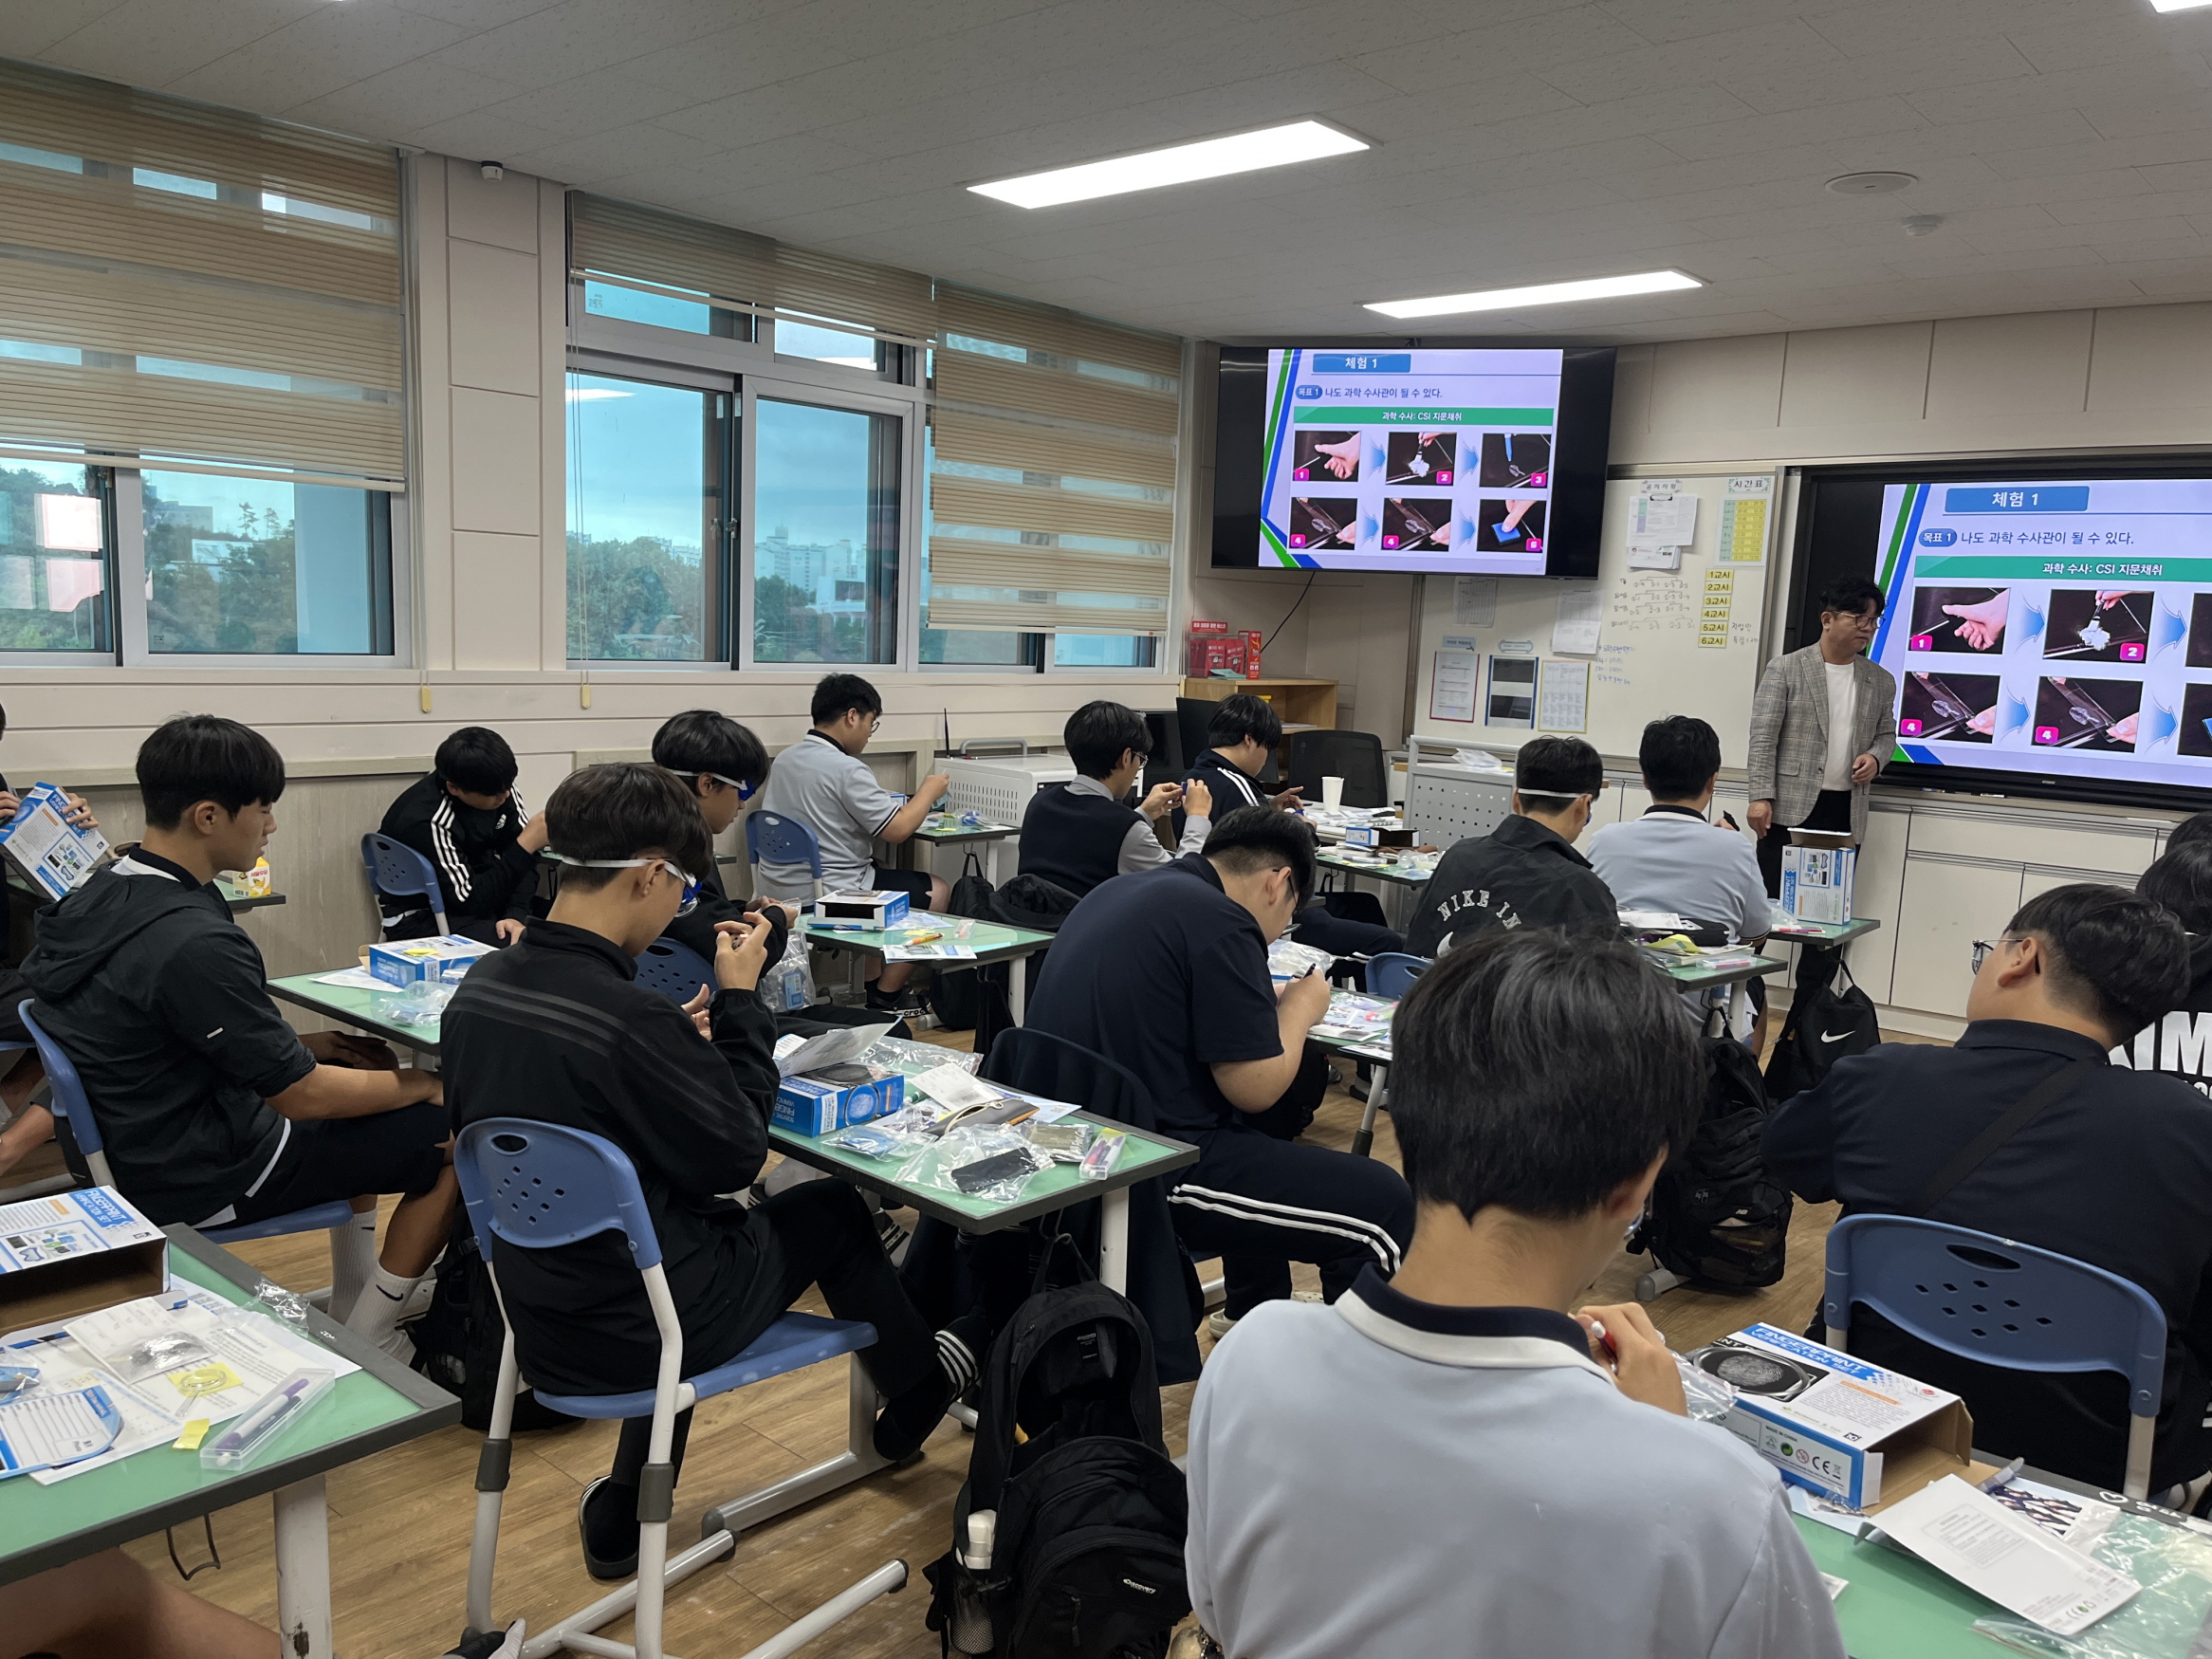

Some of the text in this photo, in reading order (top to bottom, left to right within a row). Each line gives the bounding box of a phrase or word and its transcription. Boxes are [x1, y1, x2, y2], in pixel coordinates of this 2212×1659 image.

[1345, 357, 1377, 369] 체험 1
[1299, 387, 1442, 398] 목표 1 나도 과학 수사관이 될 수 있다.
[1382, 412, 1462, 421] 과학 수사: CSI 지문채취
[1734, 480, 1763, 488] 시간표
[1992, 491, 2038, 508] 체험 1
[1923, 532, 2134, 545] 목표 1 나도 과학 수사관이 될 수 있다.
[2043, 563, 2163, 576] 과학 수사: CSI 지문채취
[1703, 623, 1724, 632] 5교시
[2128, 648, 2137, 656] 2
[1907, 723, 1915, 731] 4
[2042, 730, 2051, 739] 4
[1437, 889, 1490, 922] NIKE
[84, 1190, 126, 1221] FINGERPRINT
[1751, 1331, 1860, 1375] VERIFICATION SET
[1755, 1327, 1867, 1373] FINGERPRINT
[1766, 1425, 1778, 1434] MADE
[1784, 1434, 1798, 1443] CHINA
